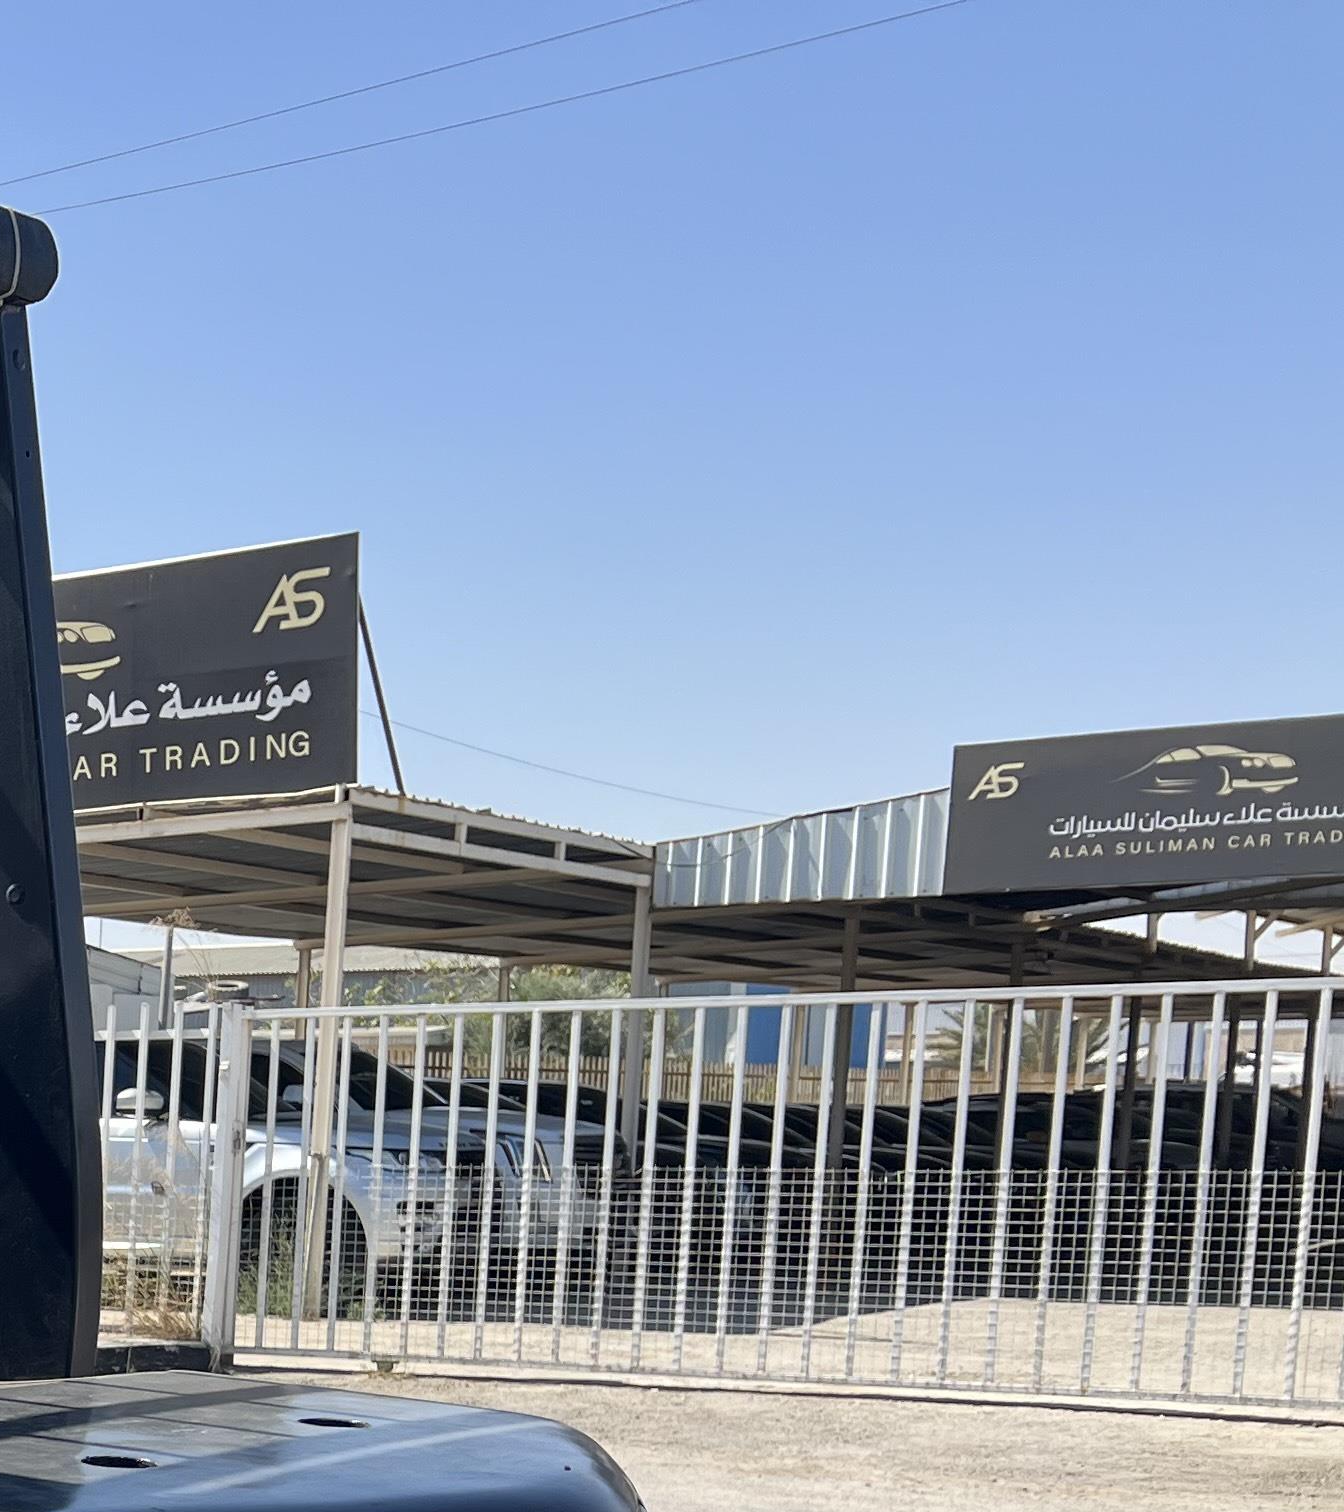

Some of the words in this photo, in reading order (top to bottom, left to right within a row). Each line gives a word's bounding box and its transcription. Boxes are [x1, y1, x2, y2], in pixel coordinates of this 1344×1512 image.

[252, 566, 331, 633] AS
[158, 669, 312, 722] مؤسسة
[73, 753, 118, 781] AR
[139, 730, 311, 774] TRADING
[968, 762, 1025, 800] AS
[1049, 811, 1136, 839] للسيارات
[1138, 807, 1222, 833] سليمان
[1223, 802, 1272, 826] علاء
[1049, 844, 1104, 859] ALAA
[1115, 837, 1216, 855] SULIMAN
[1228, 832, 1272, 849] CAR
[1284, 829, 1344, 845] TRAD
